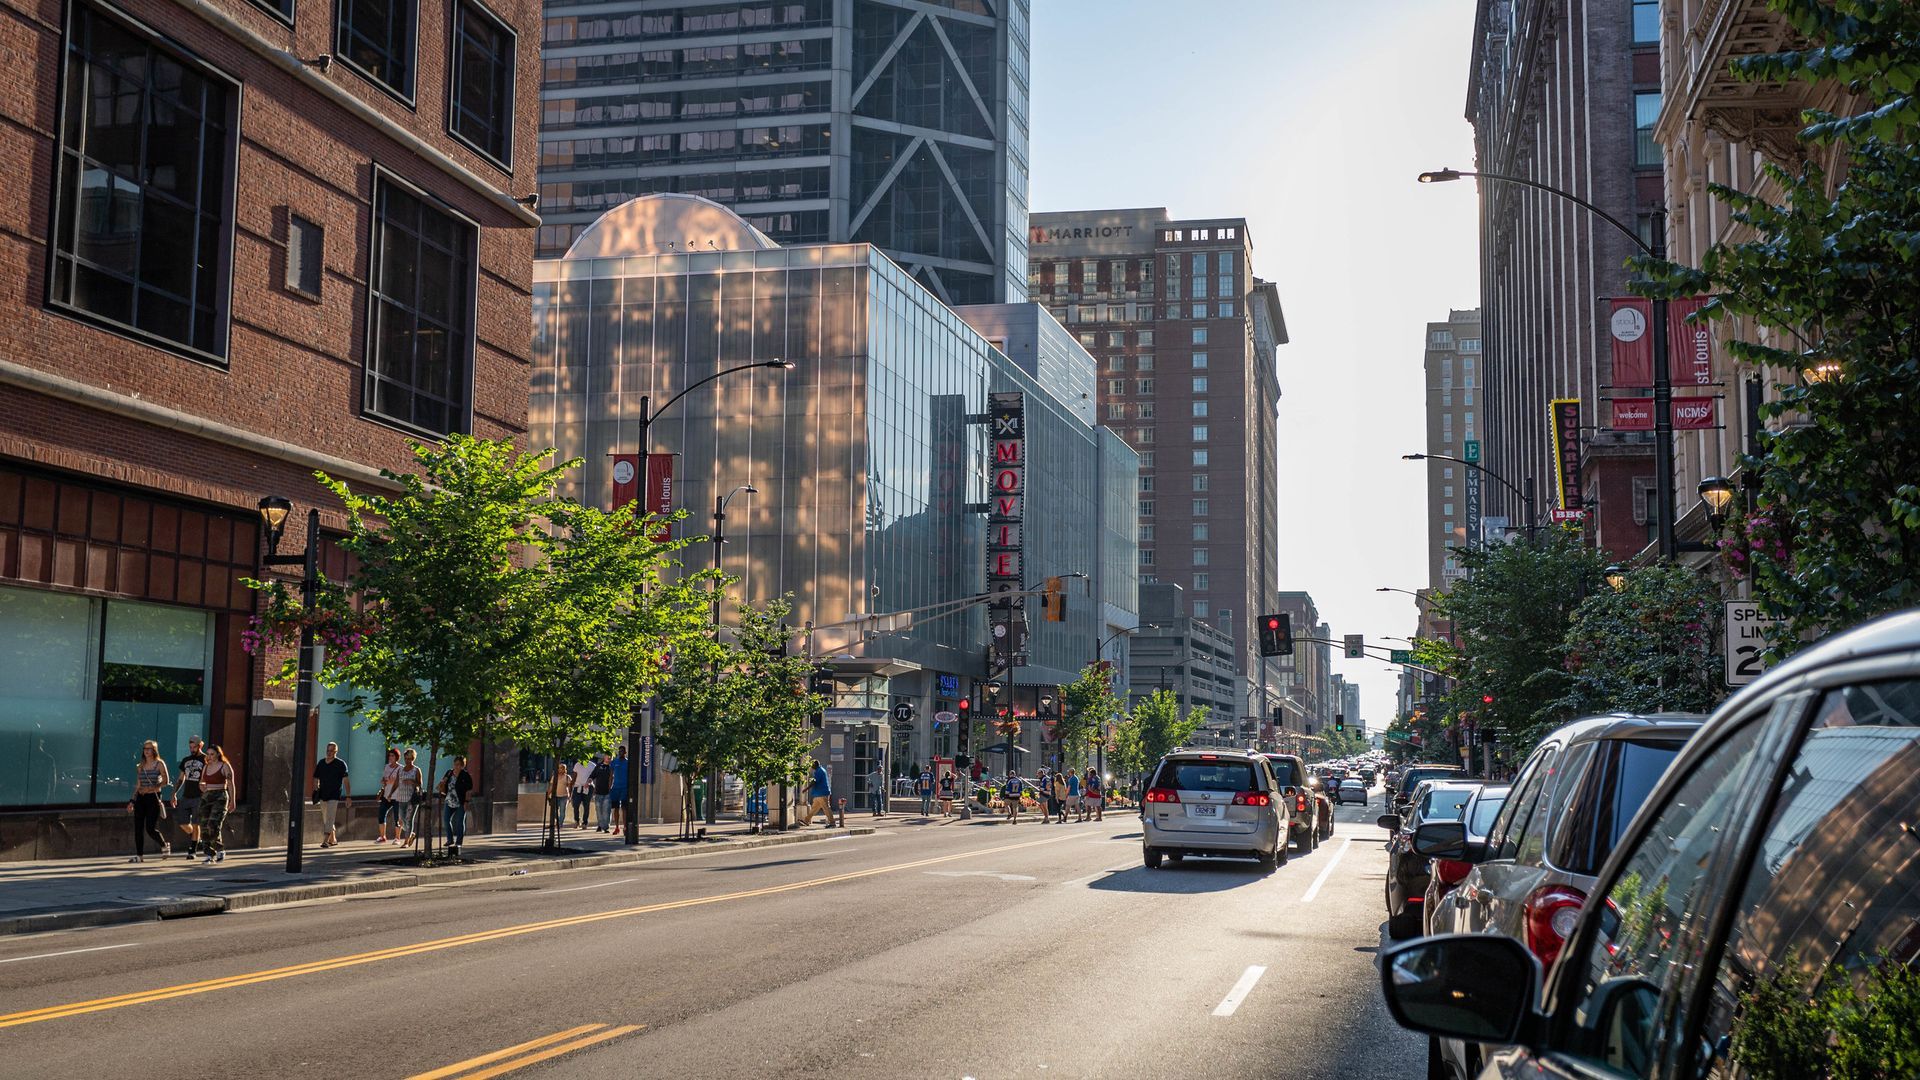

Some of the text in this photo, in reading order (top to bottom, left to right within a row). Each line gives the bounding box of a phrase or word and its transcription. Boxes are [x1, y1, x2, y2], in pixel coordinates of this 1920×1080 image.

[1048, 226, 1133, 239] MARRIOTT
[1692, 331, 1709, 384] st. louis
[1619, 411, 1648, 419] welcome
[1676, 407, 1708, 418] NCMS
[1564, 406, 1579, 508] SUGARFIRE
[661, 478, 671, 500] louis
[1467, 469, 1478, 532] EMBASSY
